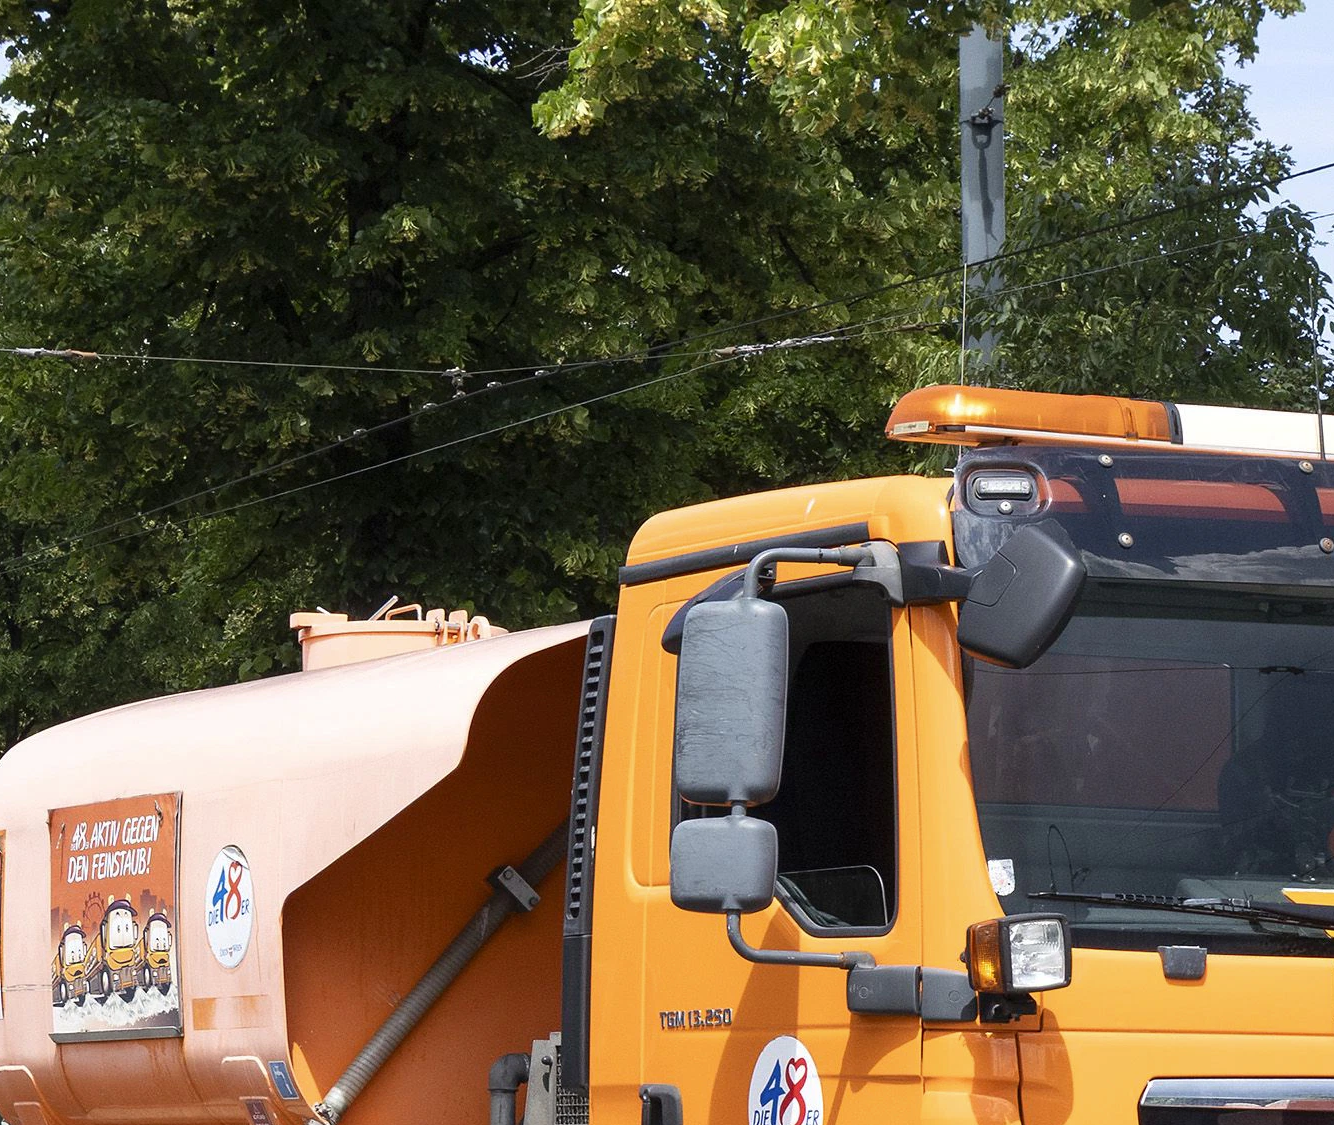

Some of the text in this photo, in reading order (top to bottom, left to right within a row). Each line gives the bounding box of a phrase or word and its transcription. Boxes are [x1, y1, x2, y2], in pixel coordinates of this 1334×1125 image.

[90, 820, 120, 849] AKTIV
[121, 815, 159, 845] GEGEN
[68, 847, 151, 883] DEN FEINSTAUB!
[659, 1008, 733, 1030] TGM 13.250
